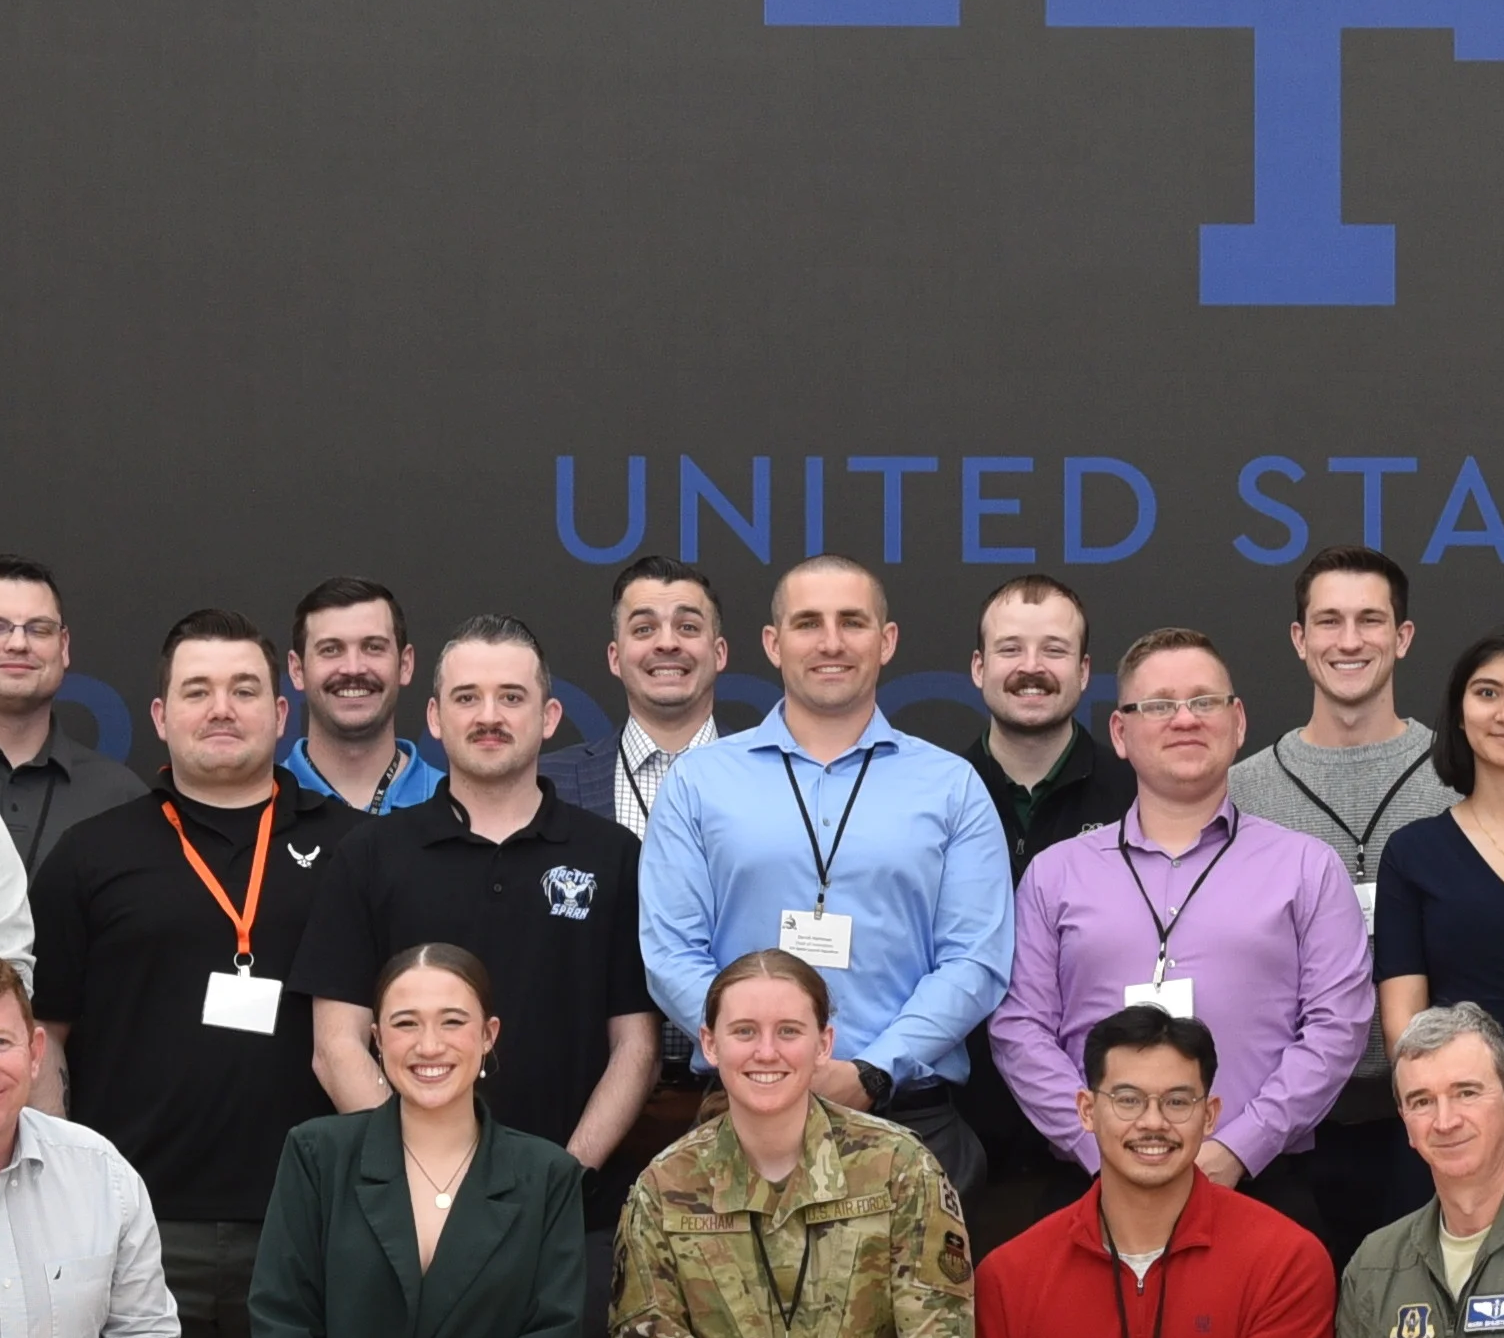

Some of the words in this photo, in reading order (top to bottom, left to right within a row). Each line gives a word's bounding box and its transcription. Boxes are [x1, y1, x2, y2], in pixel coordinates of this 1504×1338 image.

[556, 455, 1157, 564] UNITED
[833, 1201, 854, 1218] AIR
[856, 1195, 890, 1214] FORCE
[680, 1215, 735, 1231] PECKHAM
